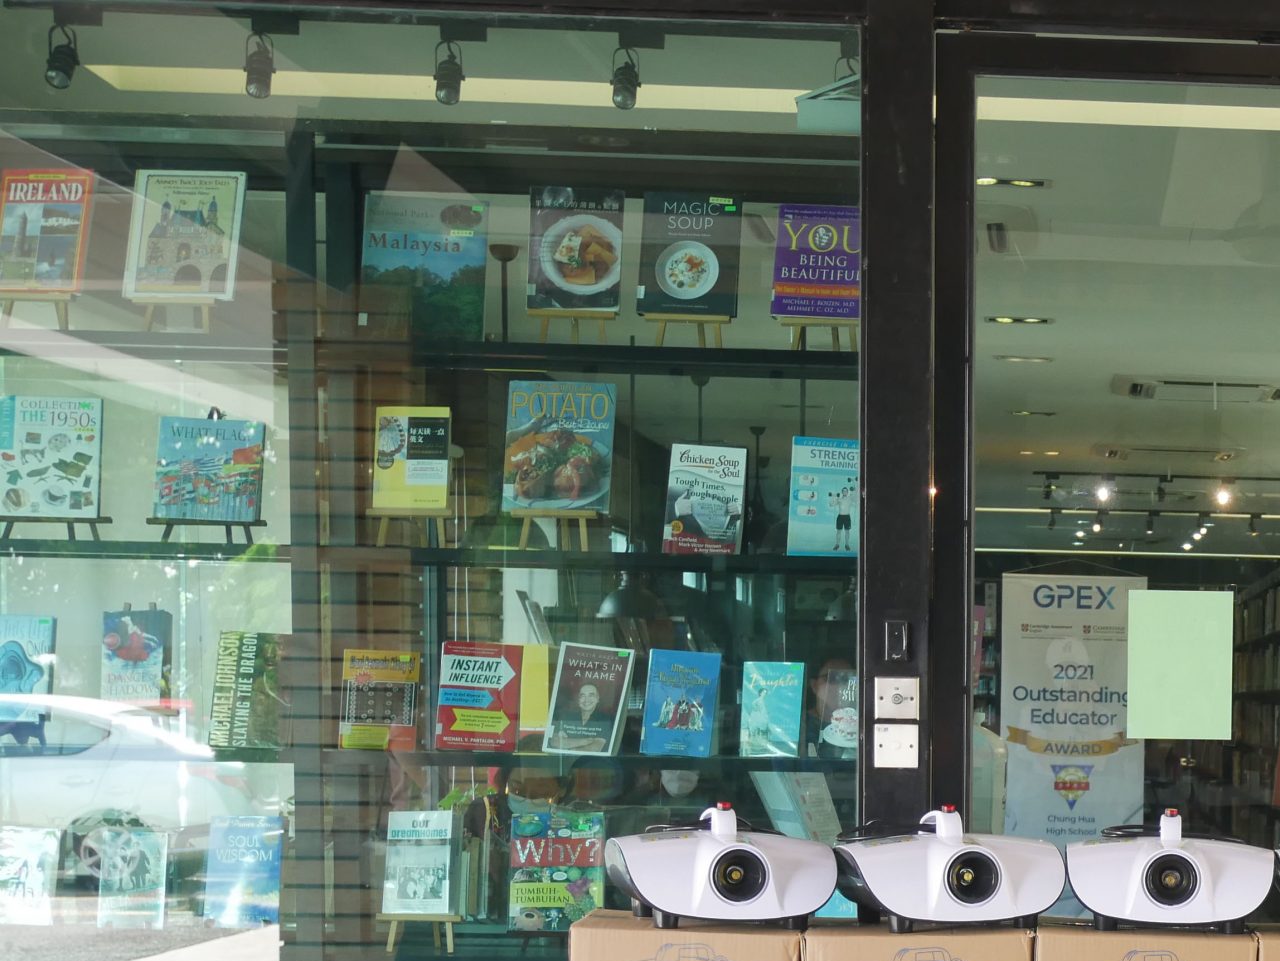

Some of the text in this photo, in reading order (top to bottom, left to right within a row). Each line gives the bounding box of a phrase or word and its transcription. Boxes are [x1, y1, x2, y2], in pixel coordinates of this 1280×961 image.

[9, 182, 83, 201] IRELAND
[664, 201, 720, 216] MAGIC
[668, 216, 714, 230] SOUP
[368, 232, 461, 257] Malaysia
[784, 223, 860, 253] YOU
[800, 254, 847, 267] BEING
[512, 391, 609, 420] POTATO
[20, 411, 96, 428] THE 1950s
[171, 425, 207, 441] WHAT
[679, 449, 740, 468] Chicken Soup
[719, 467, 740, 478] Soul
[675, 477, 726, 492] Tough Times,
[686, 489, 738, 504] Tough People
[1034, 584, 1116, 610] GPEX
[450, 659, 502, 672] INSTANT
[569, 658, 623, 672] WHAT'S IN
[1054, 664, 1094, 680] 2021
[449, 672, 503, 684] INFLUENCE
[574, 670, 616, 681] A NAME
[749, 672, 798, 688] Daughter
[209, 631, 240, 747] MICHAEL JOHNSON
[232, 632, 258, 747] SLAYING THE DRAGON
[1030, 708, 1117, 726] Educator
[1044, 742, 1103, 755] AWARD
[1048, 814, 1096, 824] Chung Hua
[1046, 827, 1096, 836] High School
[229, 835, 260, 847] SOUL
[216, 850, 272, 863] WISDOM
[514, 838, 600, 867] Why?
[516, 895, 570, 904] TUMBUHAN
